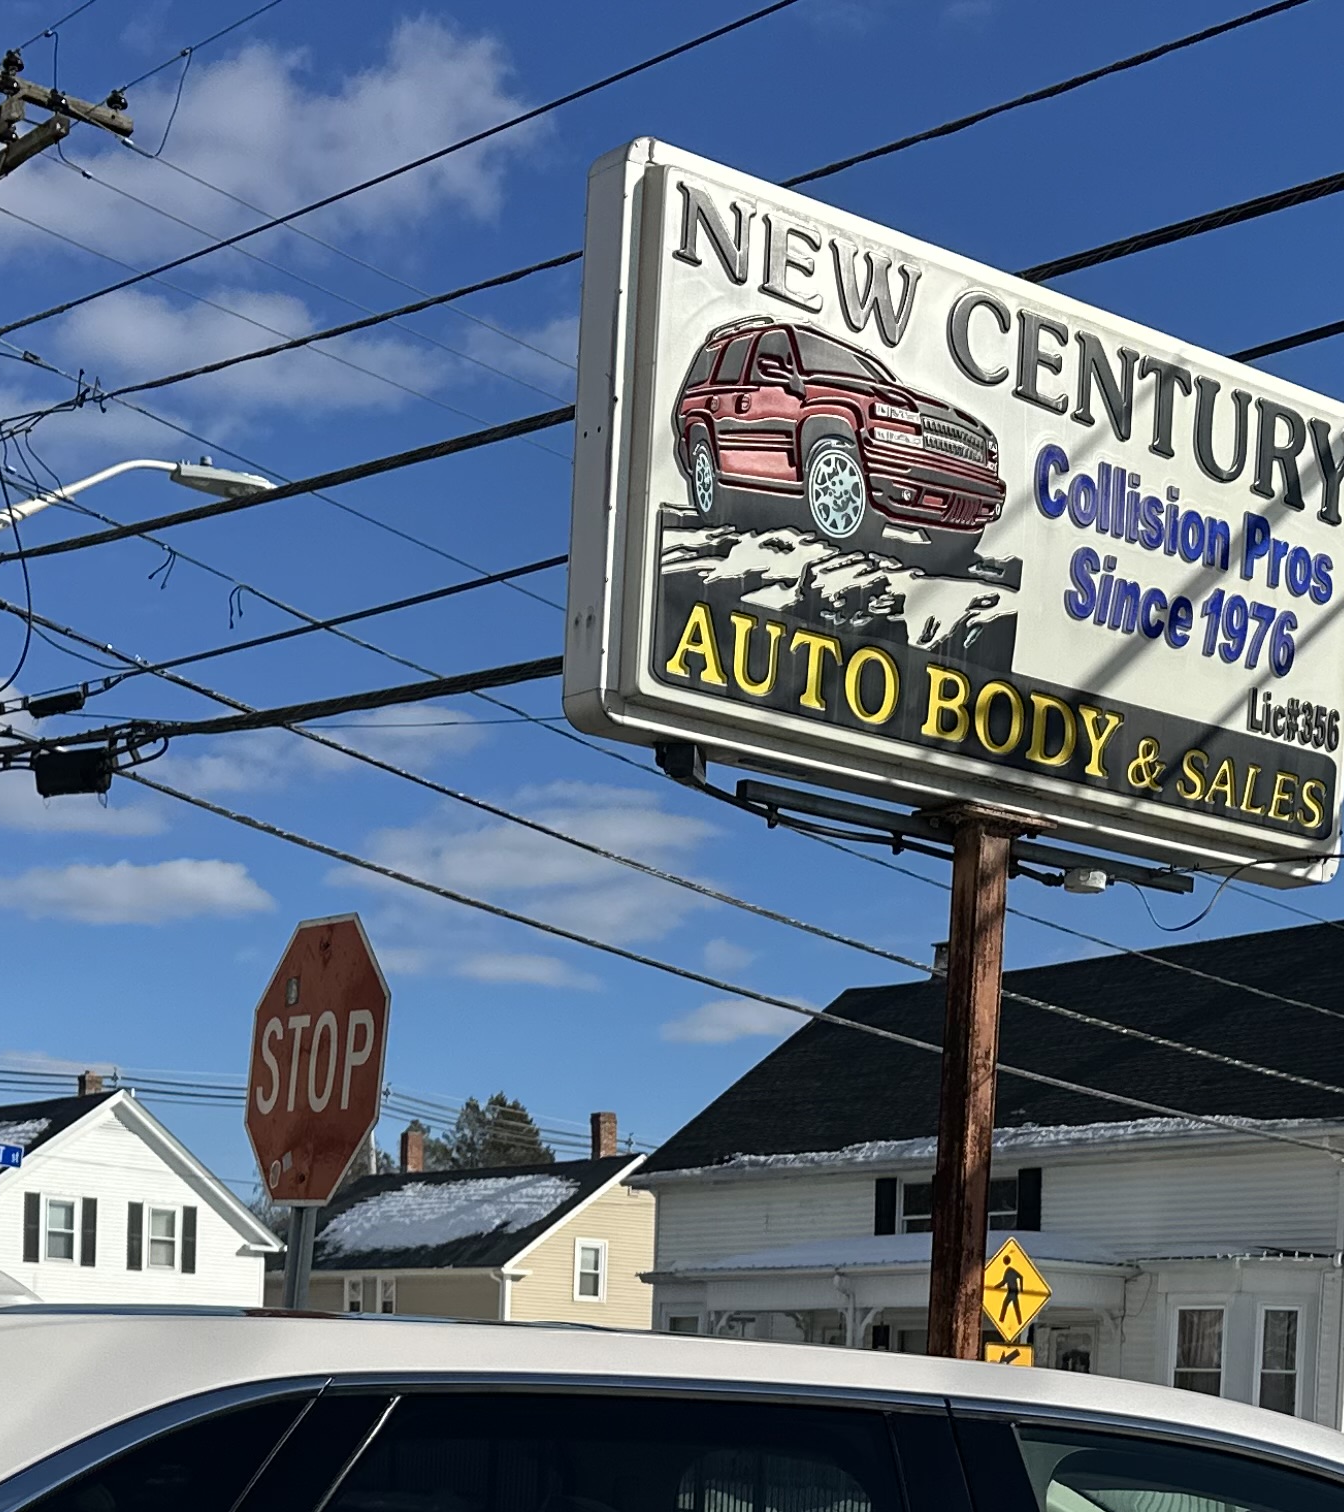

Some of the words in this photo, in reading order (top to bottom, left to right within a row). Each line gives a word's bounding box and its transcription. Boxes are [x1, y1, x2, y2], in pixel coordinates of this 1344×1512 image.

[672, 179, 923, 348] NEW
[1034, 444, 1231, 572] Collision
[1242, 512, 1335, 607] Pros
[1063, 546, 1194, 651] Since
[1200, 588, 1299, 679] 1976
[666, 601, 900, 726] AUTO
[921, 665, 1125, 779] BODY
[1127, 736, 1163, 793] &
[1176, 748, 1326, 831] SALES
[1246, 687, 1341, 754] Lic#356
[256, 1009, 375, 1116] STOP
